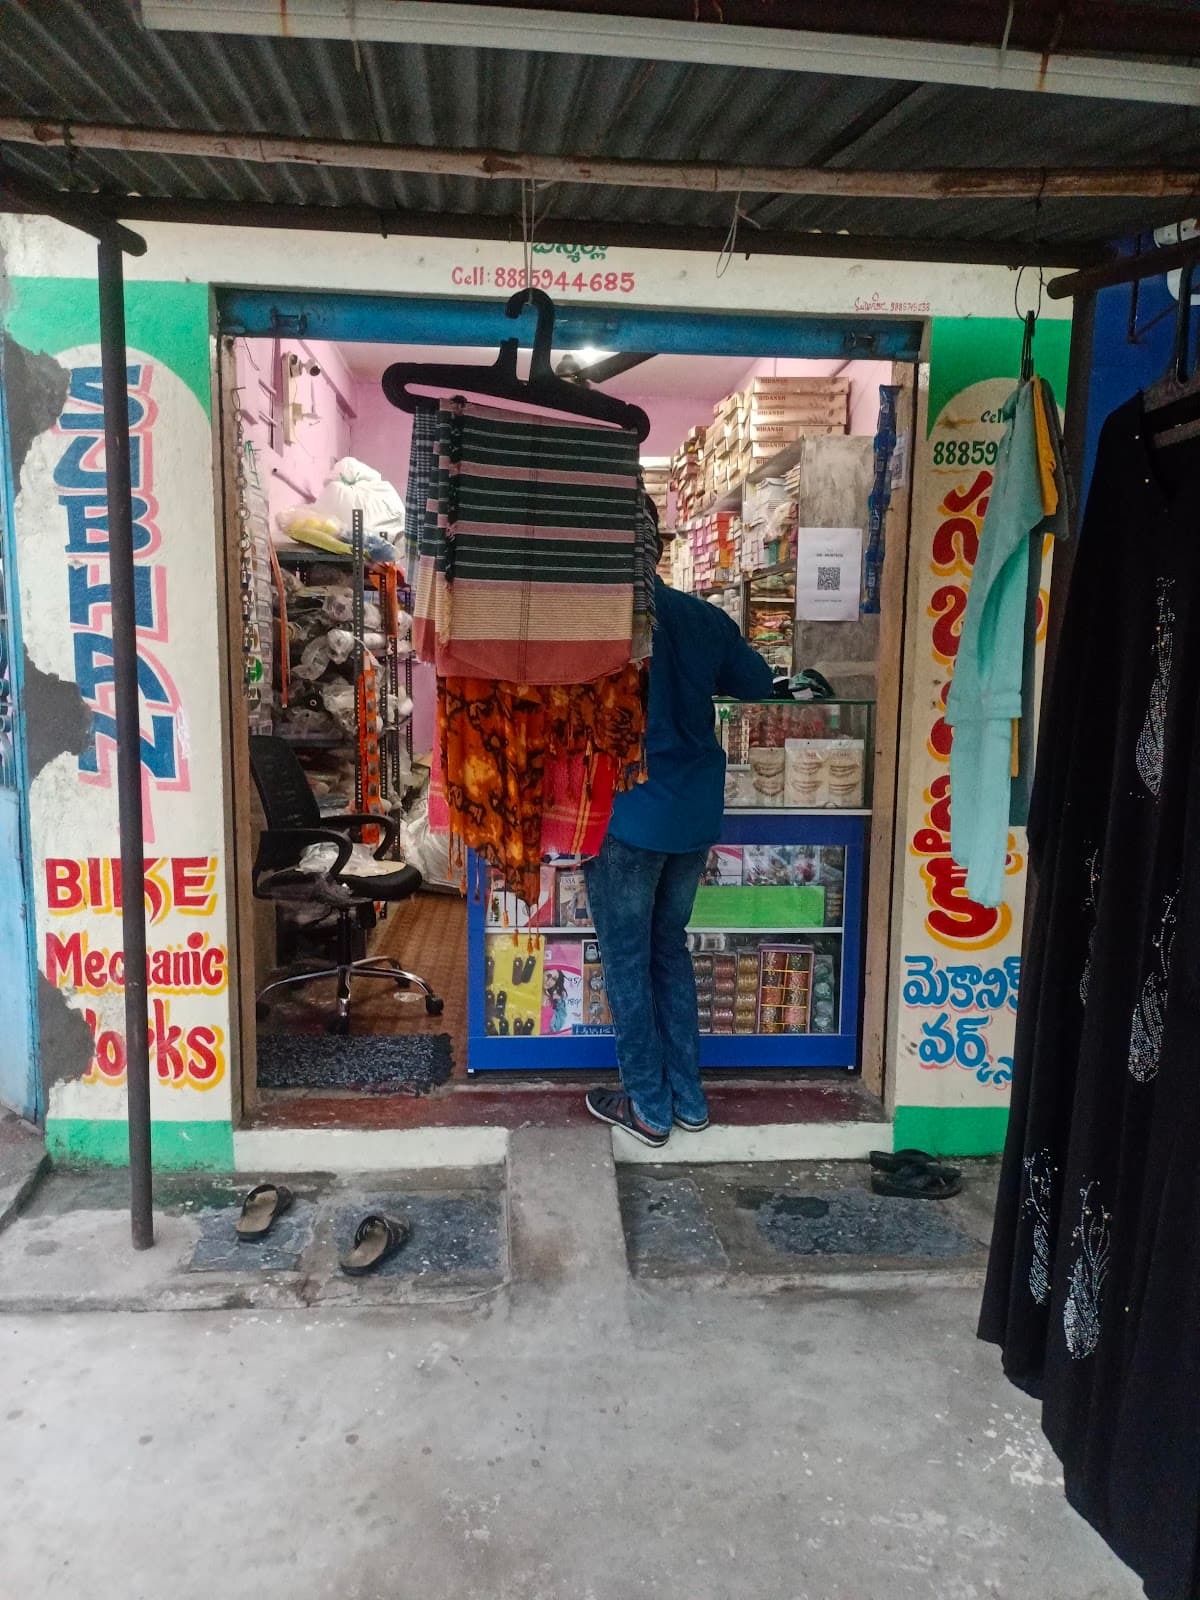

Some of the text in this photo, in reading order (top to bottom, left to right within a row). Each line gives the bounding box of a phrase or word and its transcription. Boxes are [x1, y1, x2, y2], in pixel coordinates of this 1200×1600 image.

[980, 408, 1005, 424] Cel
[933, 440, 999, 466] 88859
[46, 857, 219, 926] BIKE
[46, 932, 228, 995] Mecanic
[84, 998, 225, 1091] oks
